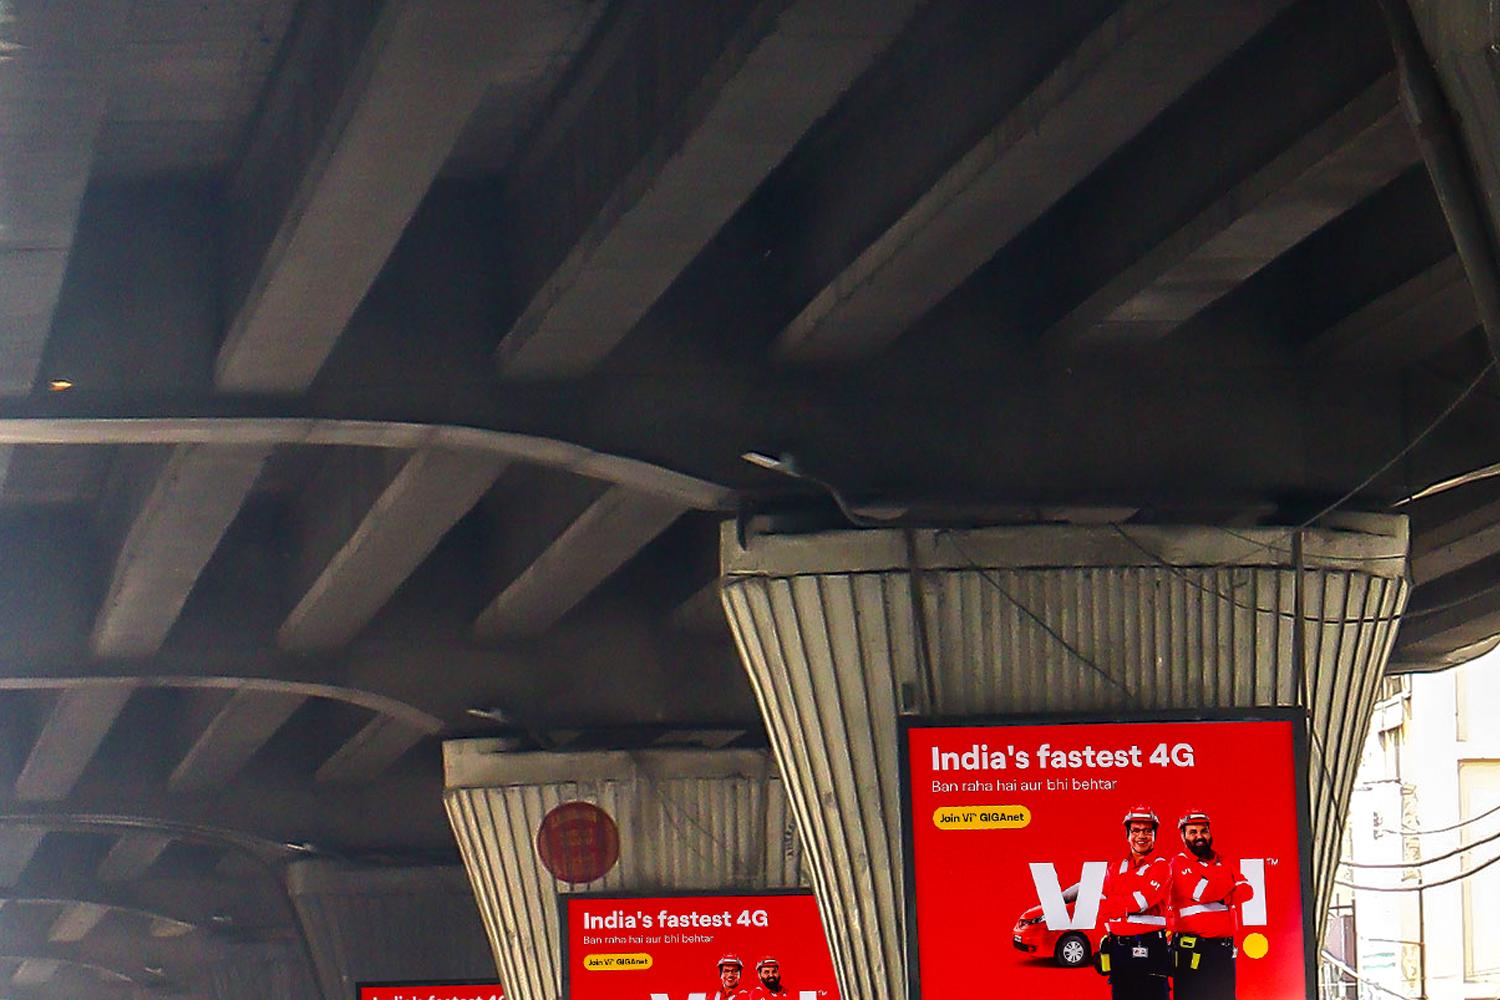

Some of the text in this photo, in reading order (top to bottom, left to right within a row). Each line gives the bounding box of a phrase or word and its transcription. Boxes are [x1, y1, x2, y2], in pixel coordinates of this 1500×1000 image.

[932, 743, 1196, 771] India's fastest 4G
[932, 778, 1118, 793] Ban raha hai aur bhi behtar
[940, 814, 960, 823] Join
[979, 813, 1025, 823] GIGAnet
[583, 910, 768, 929] India's fastest 4G
[583, 935, 602, 945] Ban
